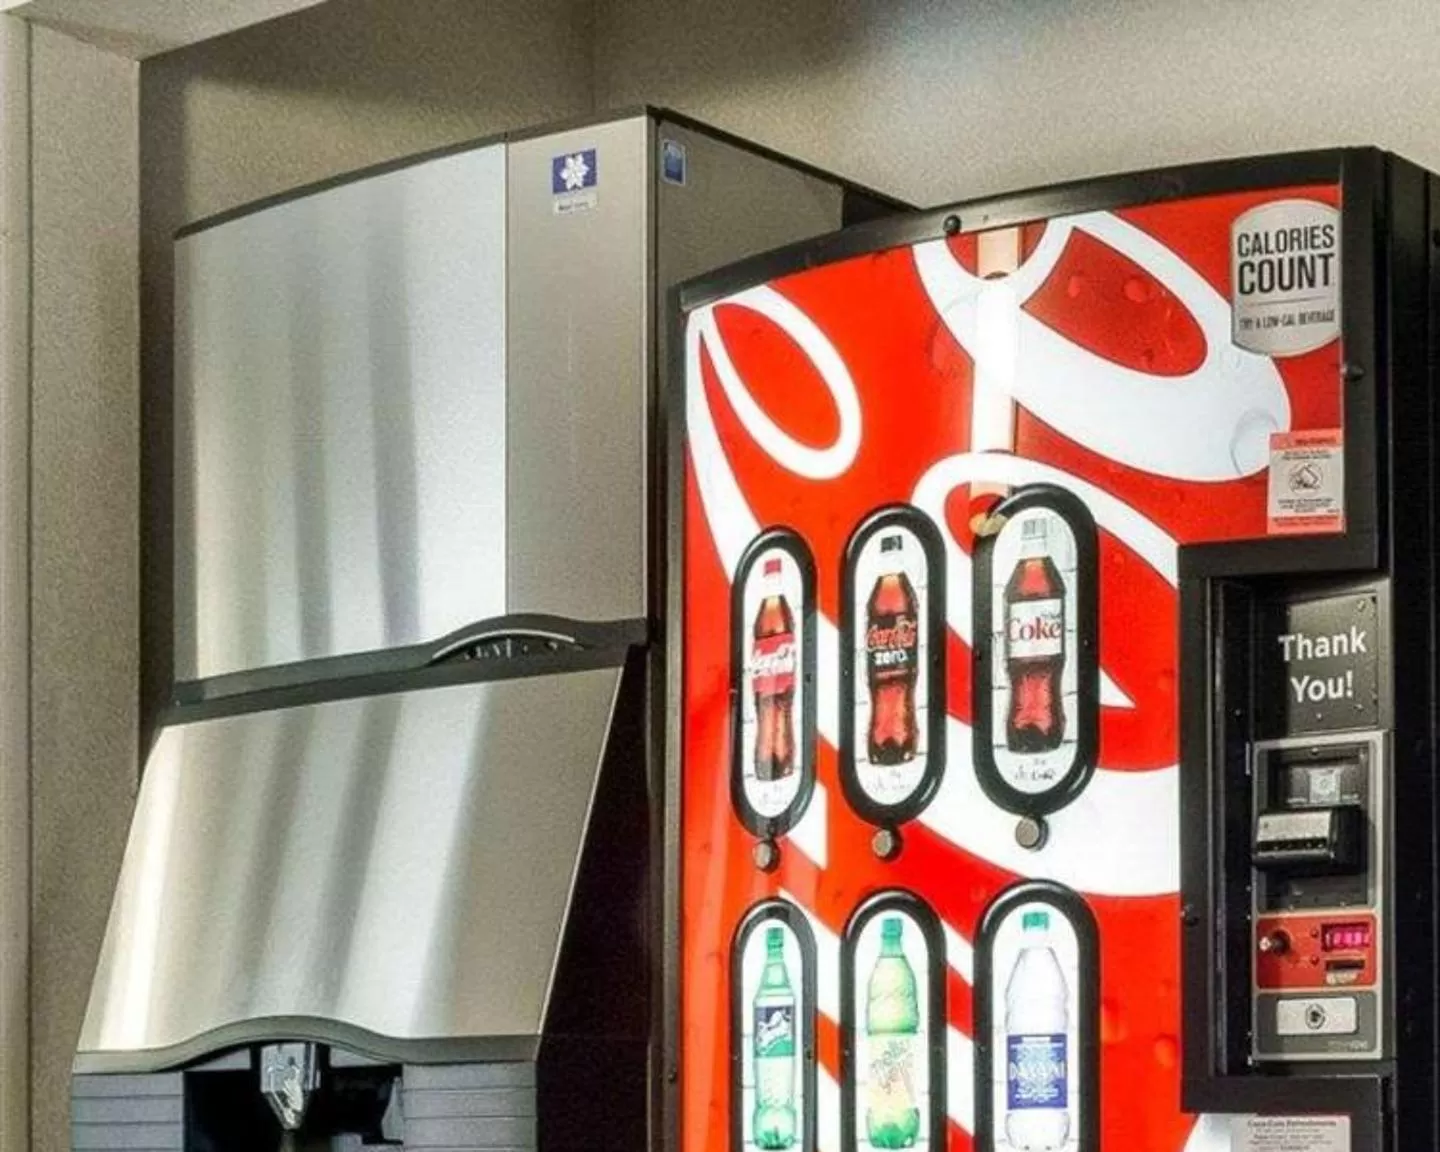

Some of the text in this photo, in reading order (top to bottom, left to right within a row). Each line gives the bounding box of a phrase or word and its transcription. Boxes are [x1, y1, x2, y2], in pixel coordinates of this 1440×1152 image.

[1237, 223, 1335, 259] CALORIES
[1238, 253, 1335, 296] COUNT
[1008, 616, 1061, 644] Coke
[1277, 626, 1368, 662] Thank
[1291, 671, 1354, 703] You!
